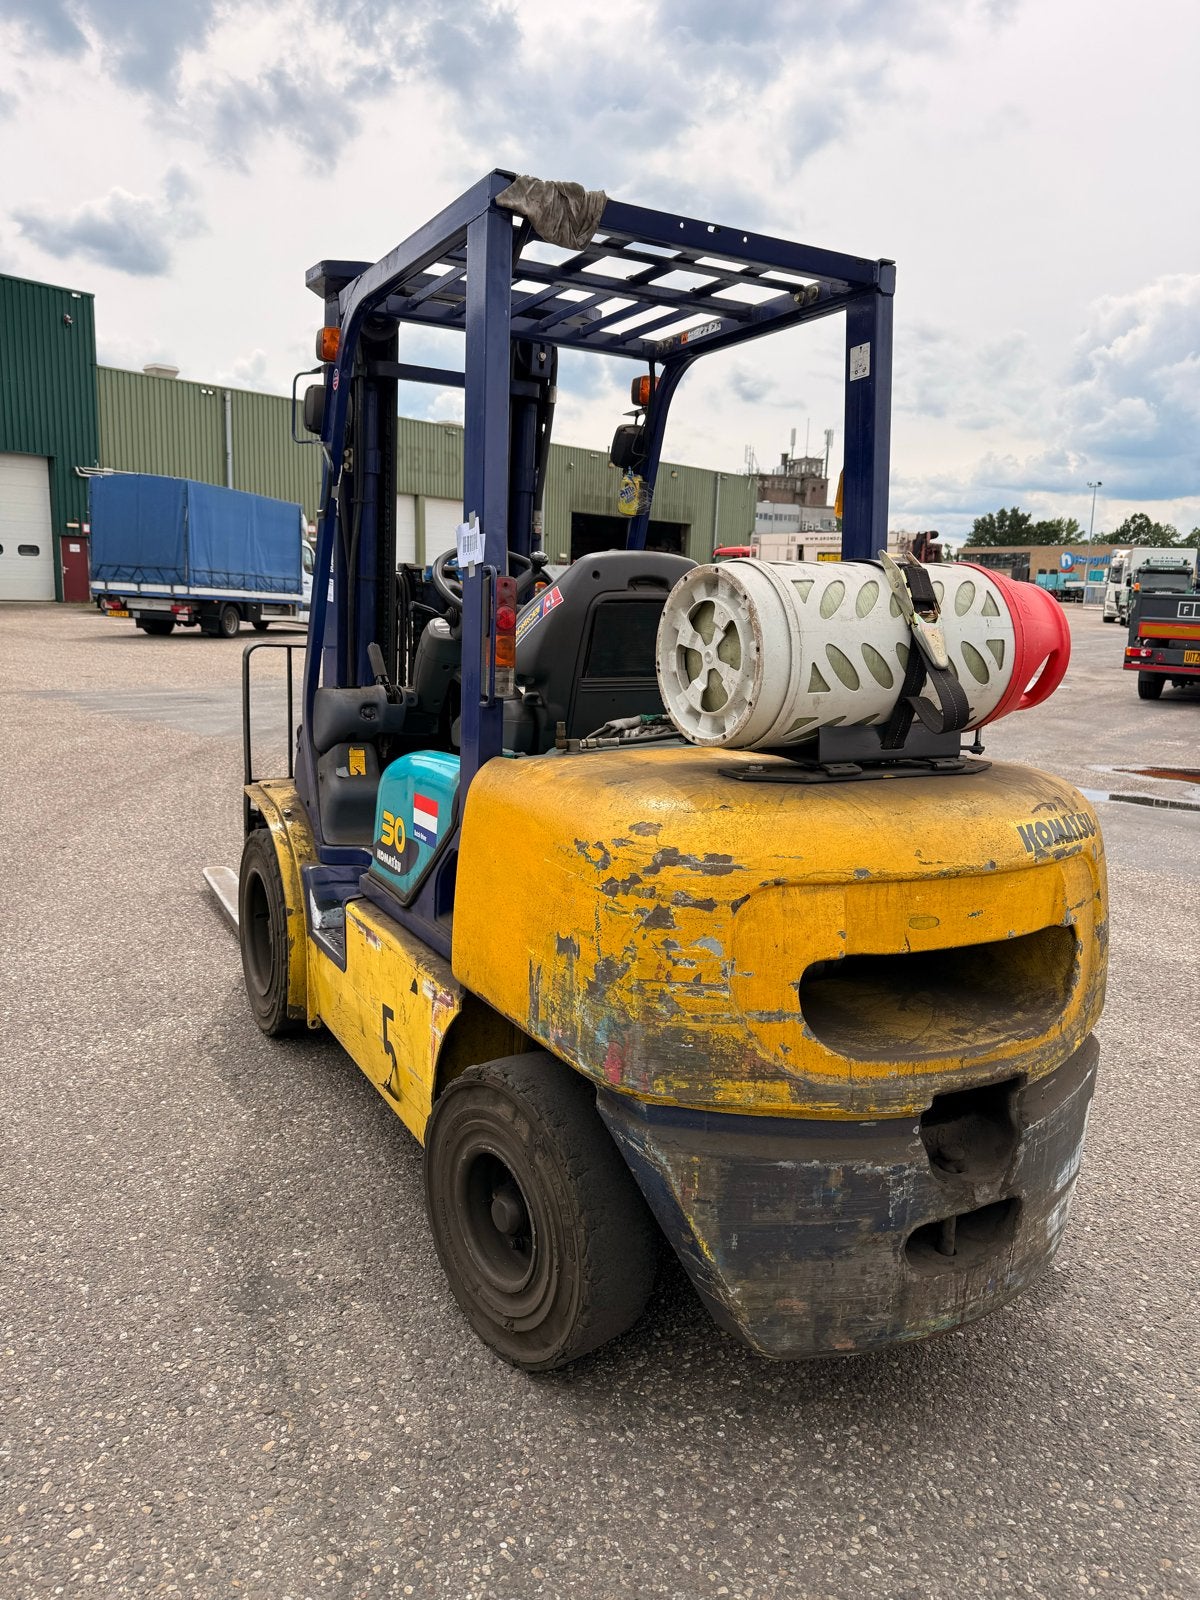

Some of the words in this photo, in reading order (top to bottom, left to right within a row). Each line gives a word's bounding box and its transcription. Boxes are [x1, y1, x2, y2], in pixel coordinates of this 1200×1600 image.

[1183, 606, 1190, 614] F
[380, 809, 406, 854] 30
[1016, 812, 1095, 853] KOMATSU
[376, 847, 402, 873] KOMATSU
